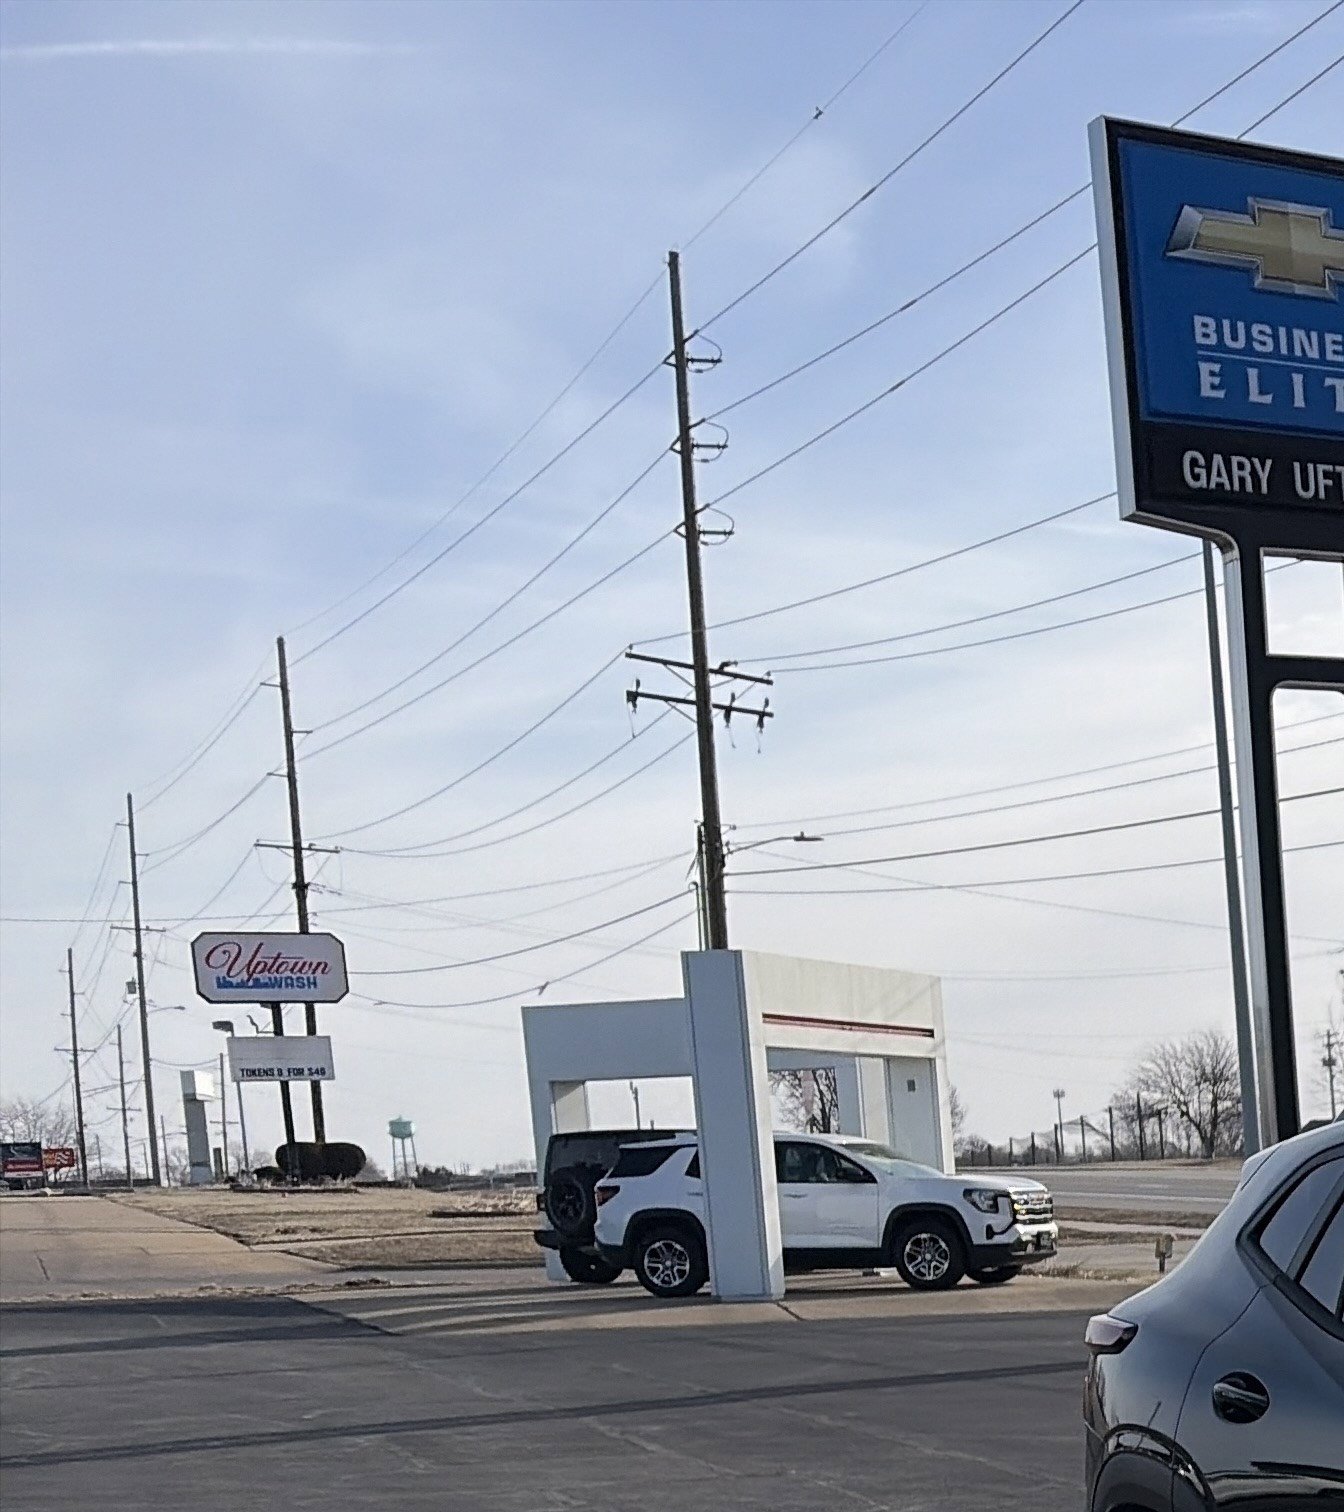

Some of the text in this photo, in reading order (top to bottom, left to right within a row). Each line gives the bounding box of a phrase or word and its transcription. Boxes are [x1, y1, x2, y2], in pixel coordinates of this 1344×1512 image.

[1182, 450, 1272, 495] GARY
[205, 941, 331, 982] Uptown
[270, 976, 318, 989] WASH
[240, 1067, 275, 1077] TOKENS
[287, 1067, 305, 1077] FOR
